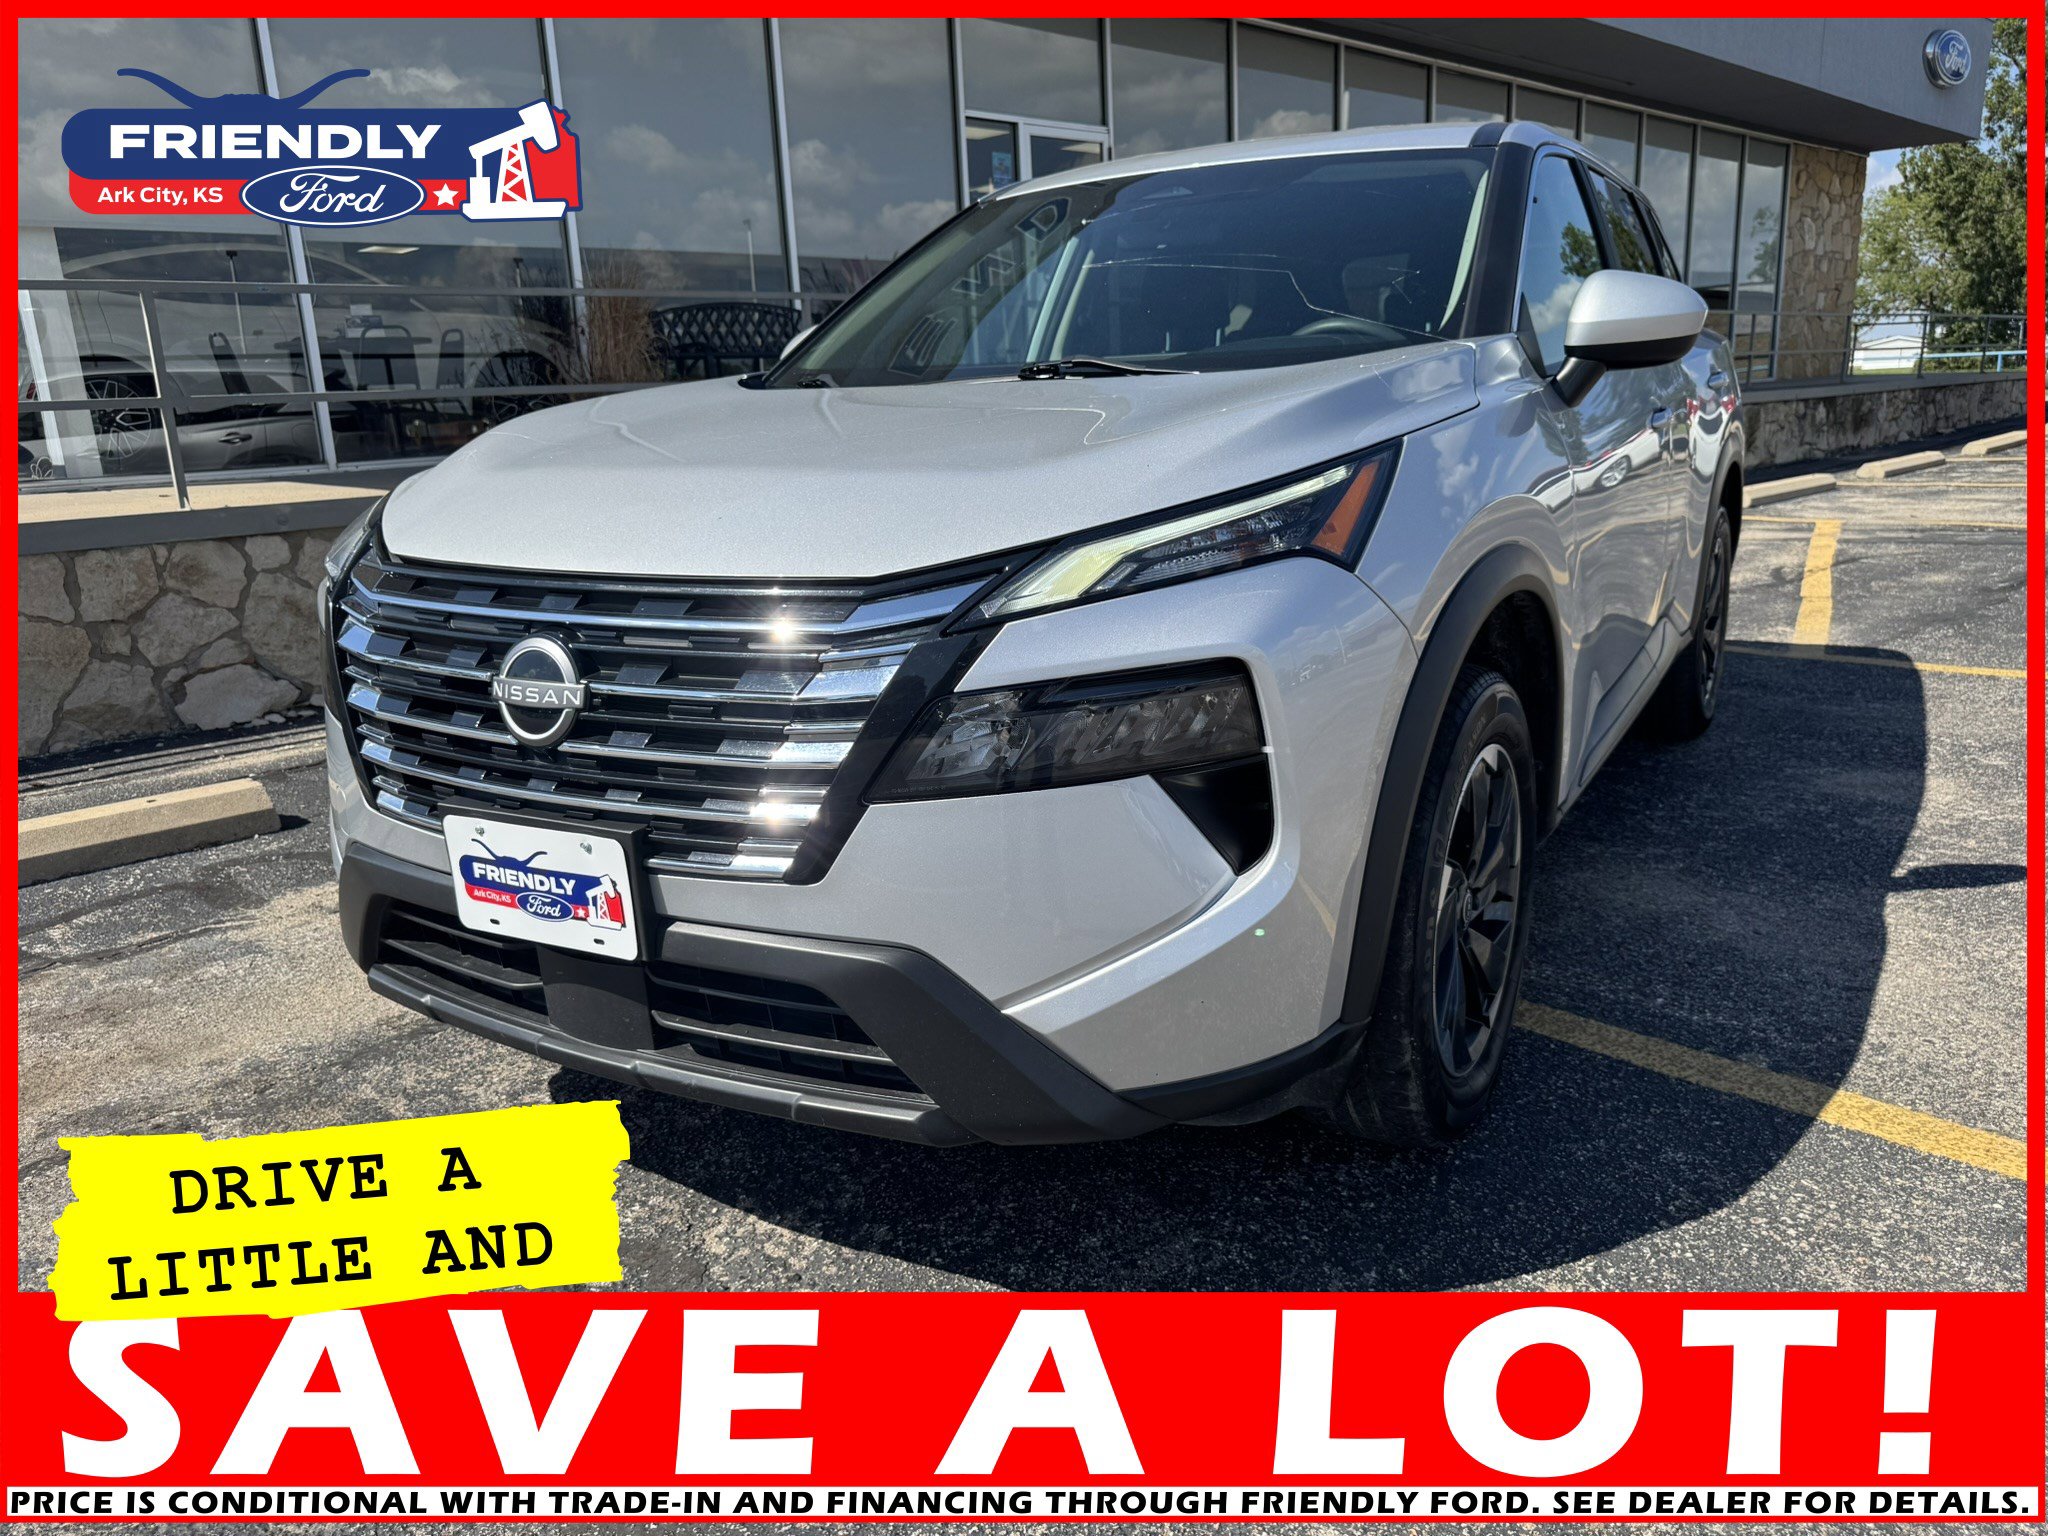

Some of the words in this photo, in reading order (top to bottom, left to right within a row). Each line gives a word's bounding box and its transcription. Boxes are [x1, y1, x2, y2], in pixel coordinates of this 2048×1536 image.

[1945, 40, 1968, 74] Ford
[492, 681, 581, 705] NISSAN
[471, 861, 576, 896] FRIENDLY
[473, 888, 486, 898] Ark
[526, 894, 561, 918] Ford
